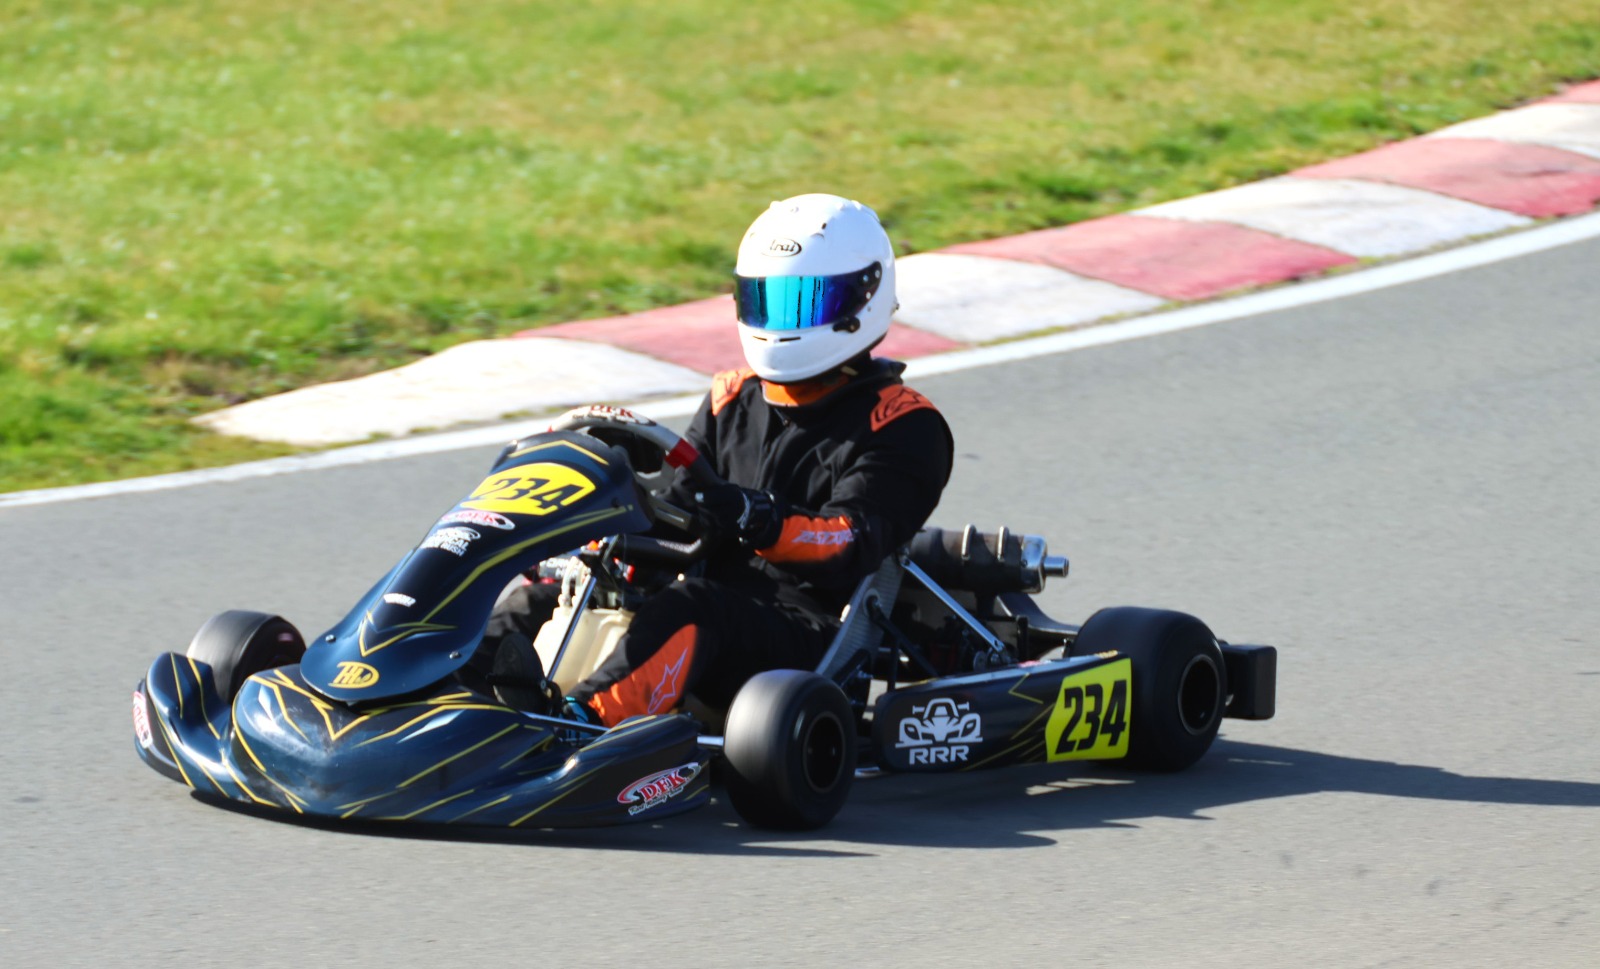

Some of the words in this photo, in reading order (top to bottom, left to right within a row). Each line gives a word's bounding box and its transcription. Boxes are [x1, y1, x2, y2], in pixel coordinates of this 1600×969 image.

[469, 477, 586, 511] 234
[1055, 680, 1127, 755] 234
[909, 745, 969, 764] RRR
